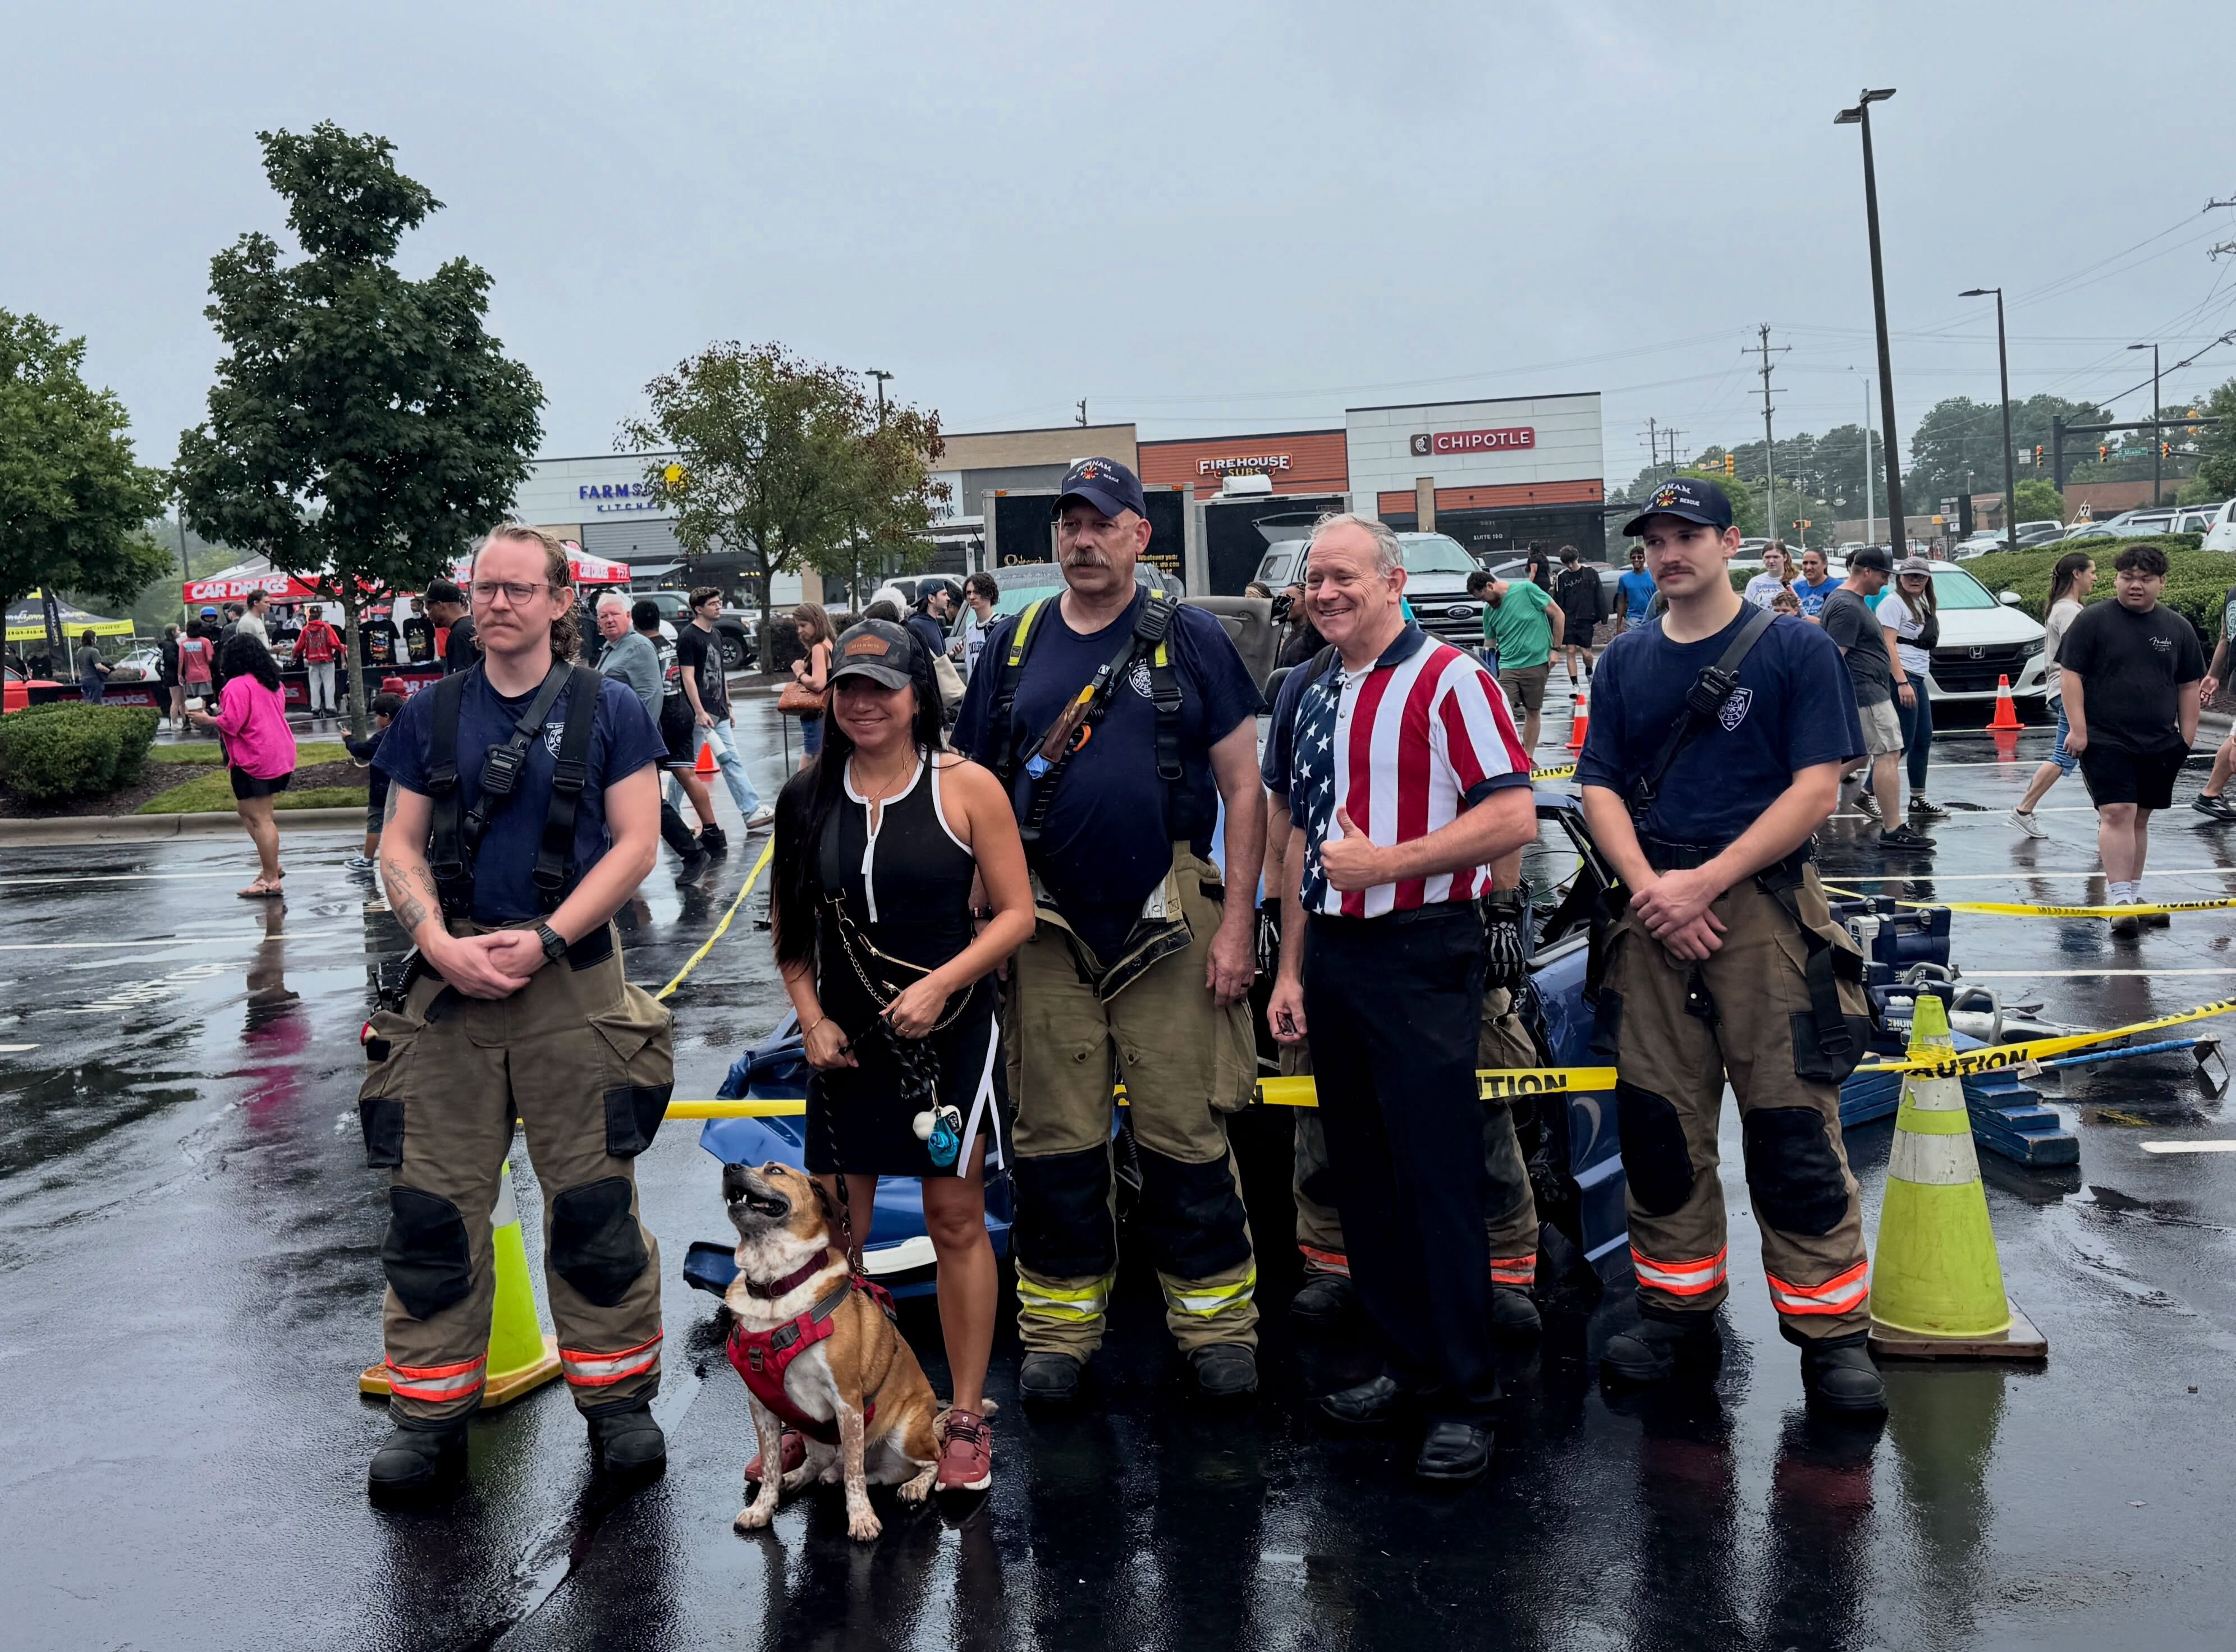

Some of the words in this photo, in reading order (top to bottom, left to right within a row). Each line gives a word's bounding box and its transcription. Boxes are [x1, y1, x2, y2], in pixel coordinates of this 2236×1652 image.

[1438, 432, 1531, 449] CHIPOTLE
[1199, 455, 1290, 475] FIREHOUSE
[1228, 467, 1262, 476] SUBS
[579, 483, 654, 499] FARMS
[597, 502, 657, 512] KITCHE
[191, 583, 227, 599] CAR
[230, 577, 288, 596] DRUGS
[1531, 765, 1574, 778] CAUTI
[1900, 969, 1927, 978] HUST
[1893, 1019, 1913, 1028] HUR
[1904, 1048, 2028, 1079] AUTION
[1477, 1074, 1567, 1097] TION
